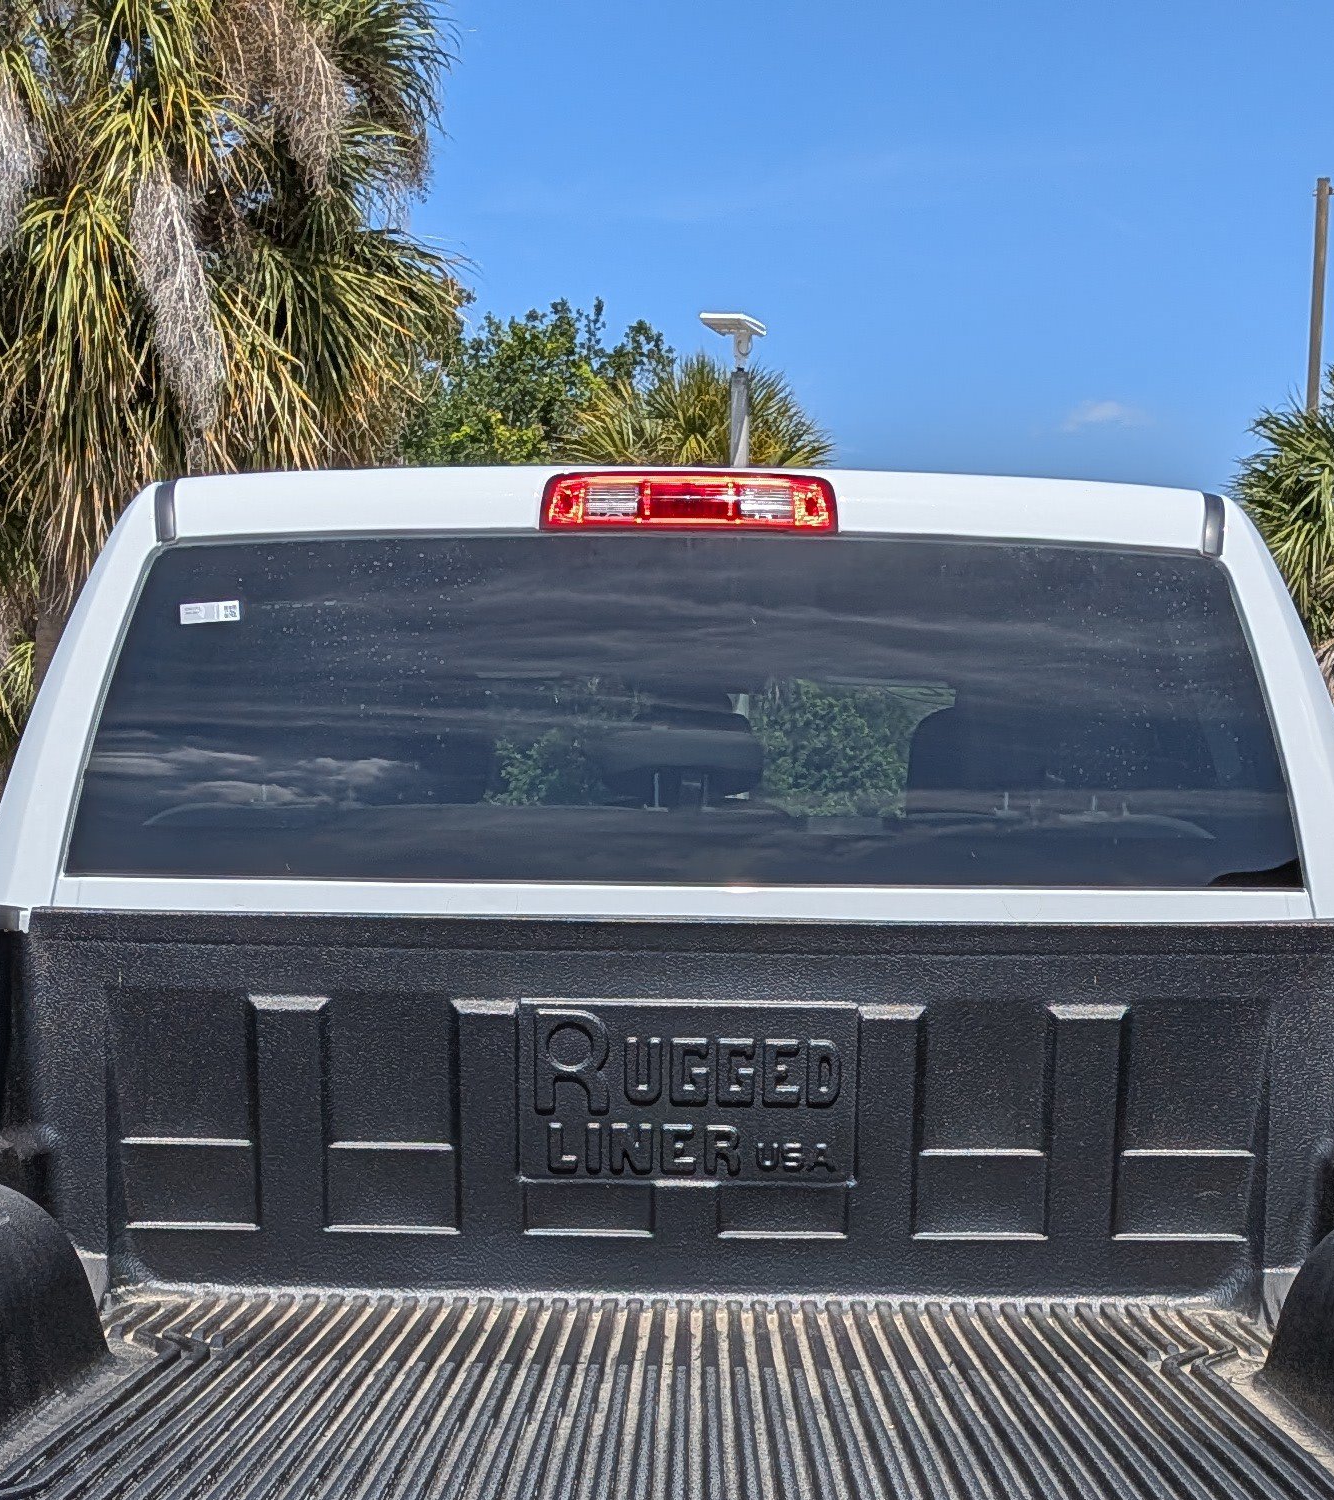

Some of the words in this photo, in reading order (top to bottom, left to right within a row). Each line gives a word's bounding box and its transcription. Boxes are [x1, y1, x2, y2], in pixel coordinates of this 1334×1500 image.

[534, 1008, 841, 1117] RUGGED
[547, 1122, 742, 1176] LINER
[755, 1142, 838, 1173] USA
